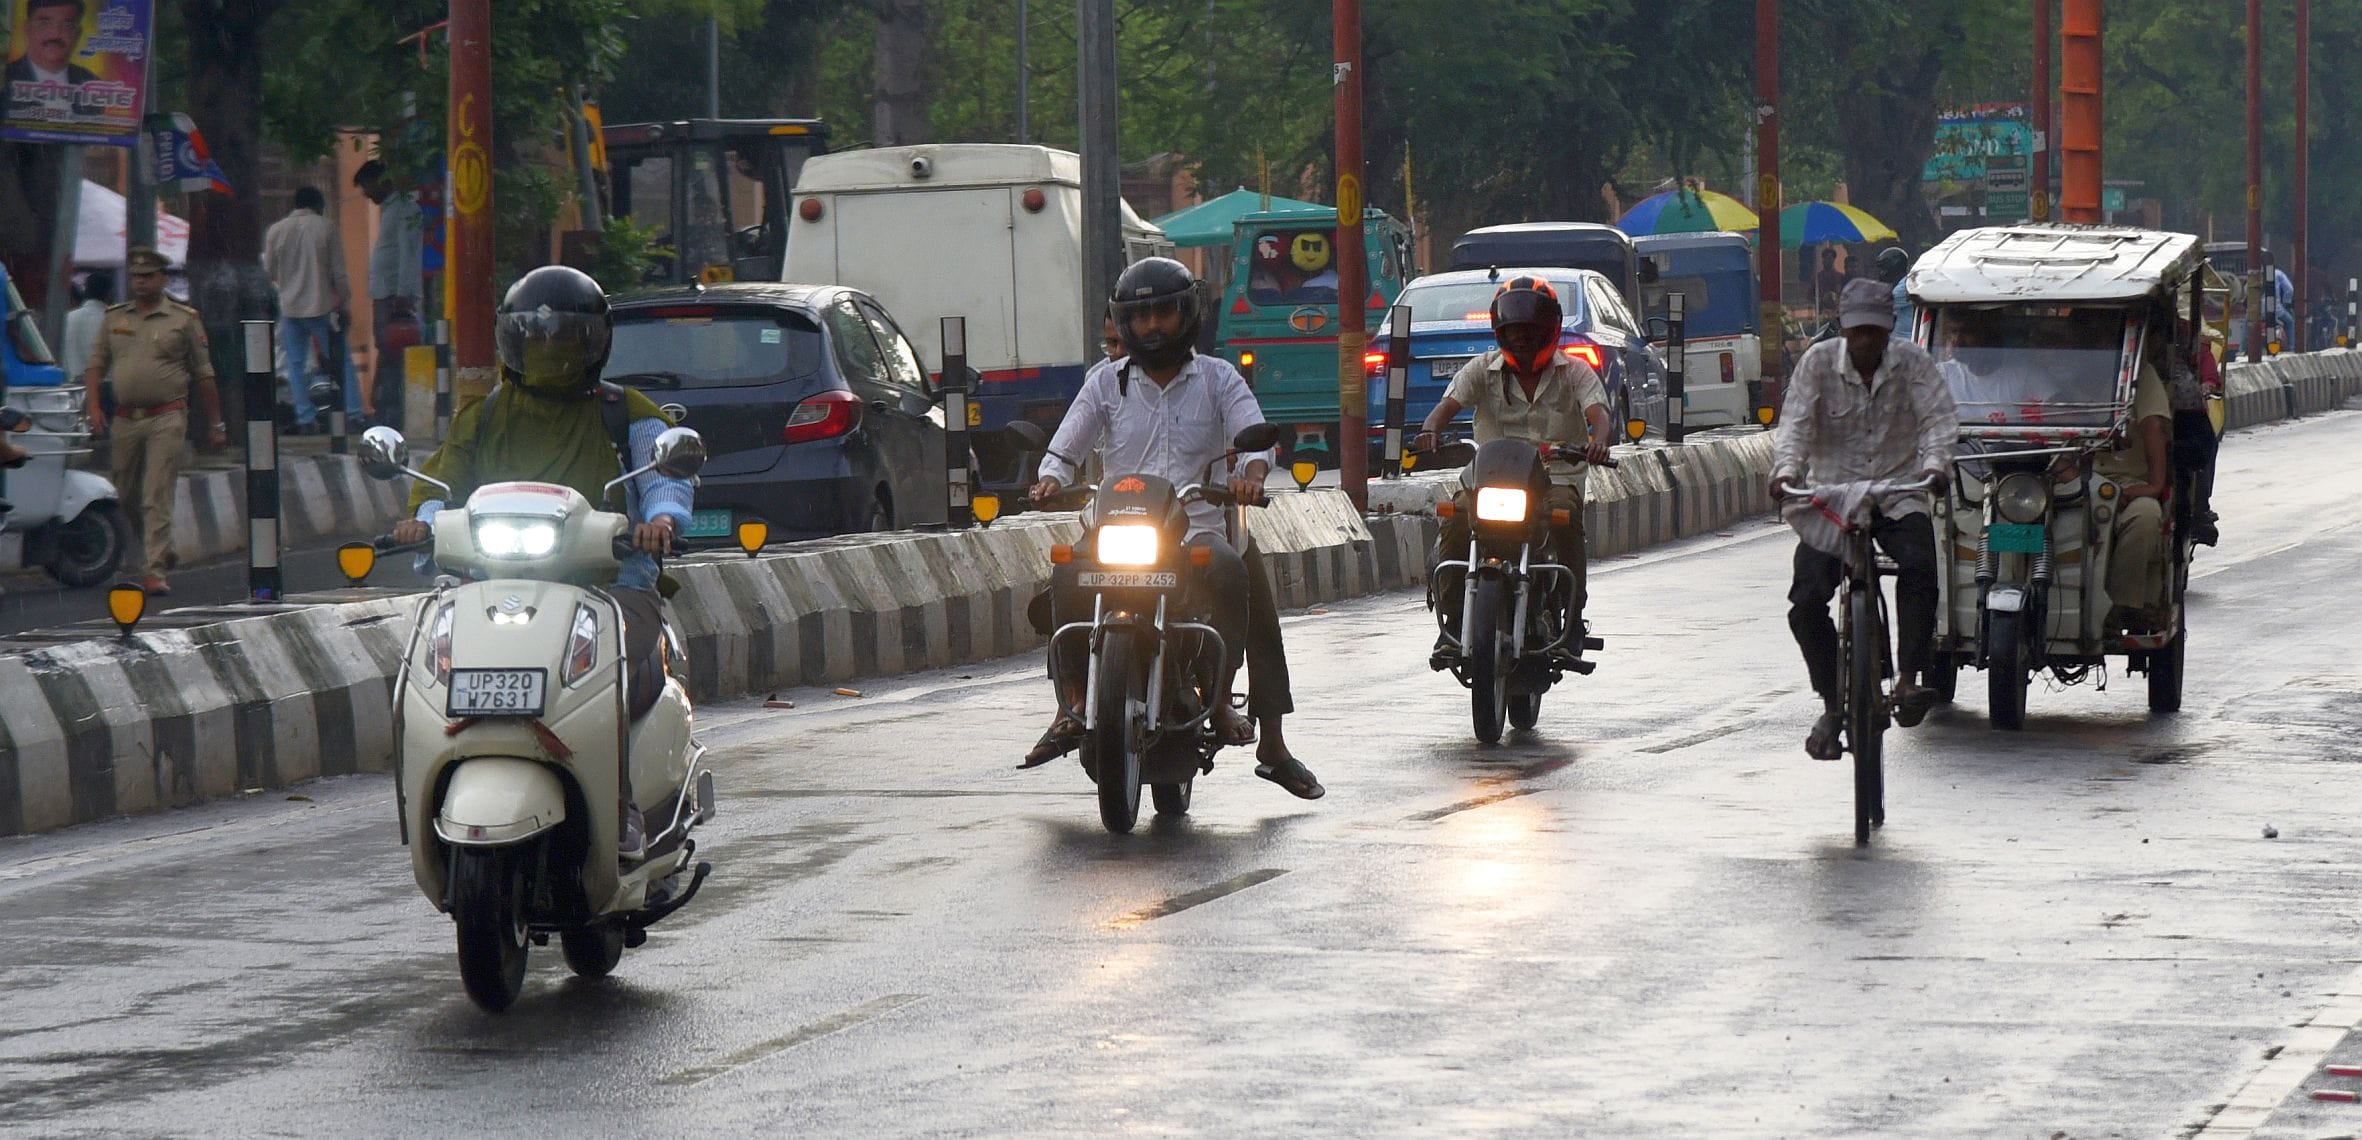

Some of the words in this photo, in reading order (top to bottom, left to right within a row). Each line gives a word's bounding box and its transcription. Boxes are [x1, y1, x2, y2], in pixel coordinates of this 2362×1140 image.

[1091, 574, 1105, 585] UP
[1110, 575, 1139, 585] 32PP
[1146, 575, 1175, 586] 2452
